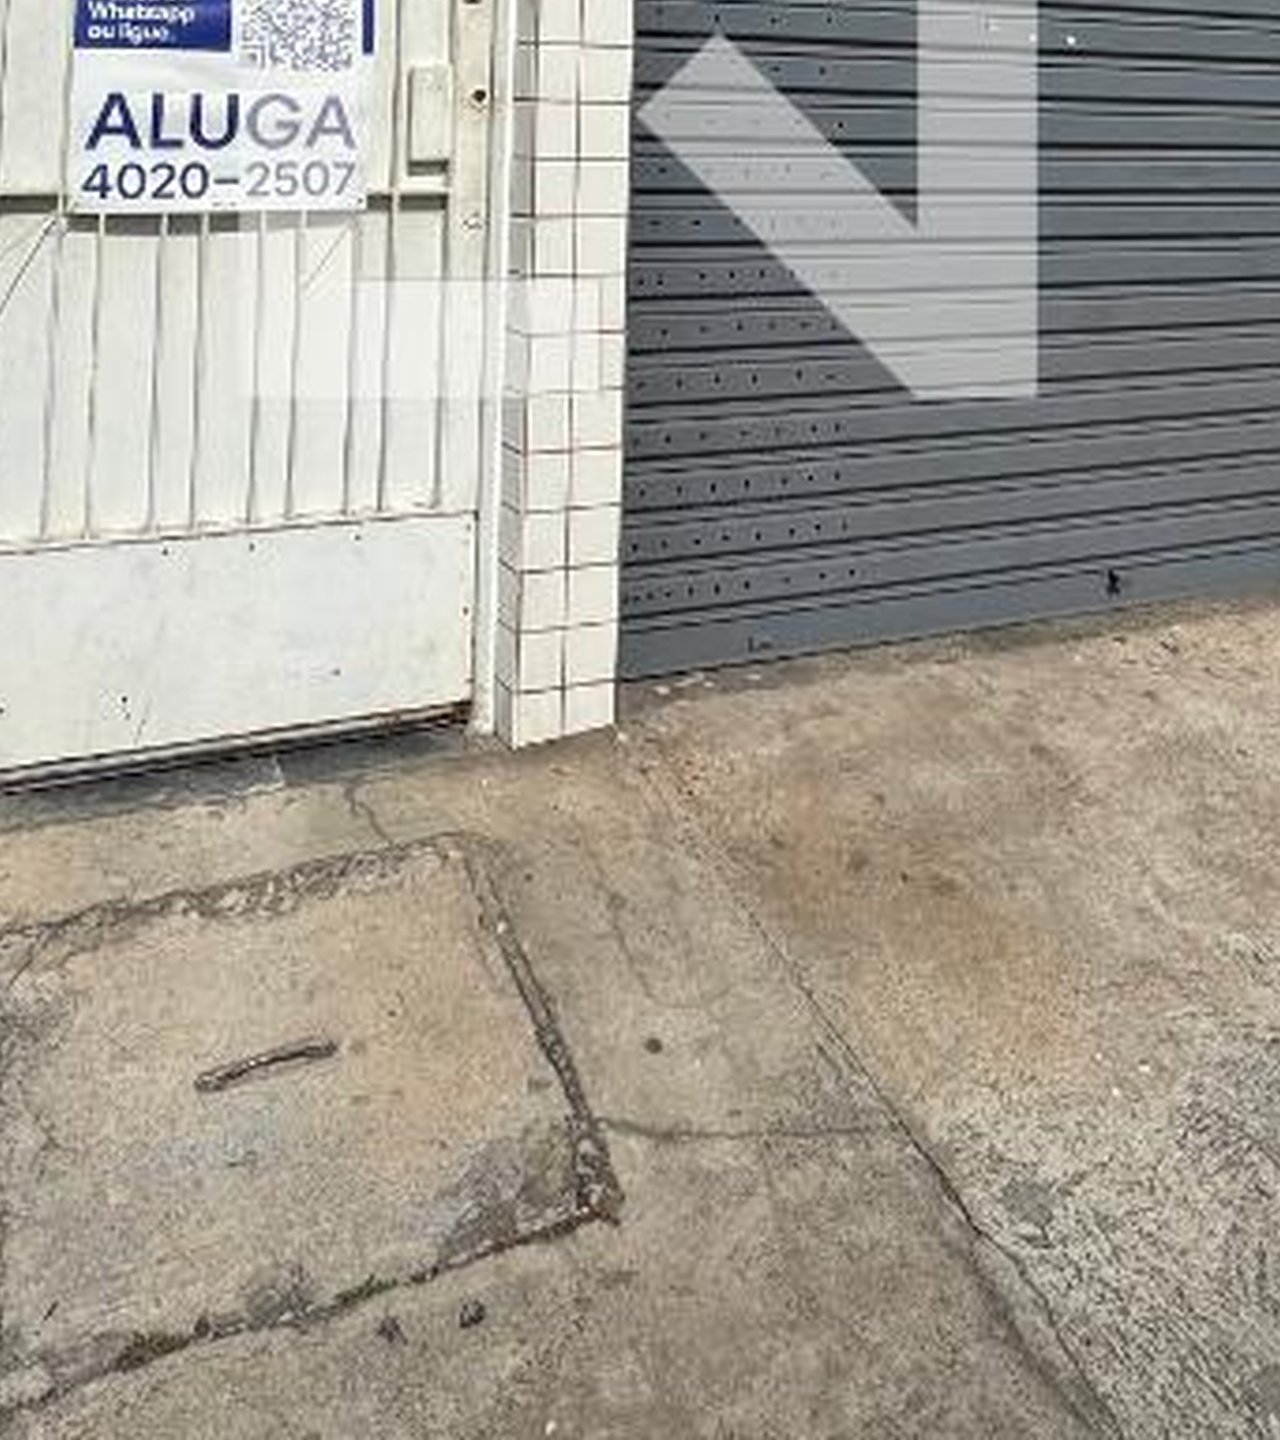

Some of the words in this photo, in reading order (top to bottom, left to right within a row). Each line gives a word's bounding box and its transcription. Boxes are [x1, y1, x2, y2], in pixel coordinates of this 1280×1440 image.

[87, 24, 116, 40] ou
[84, 91, 358, 152] ALUGA
[81, 160, 358, 200] 4020-2507
